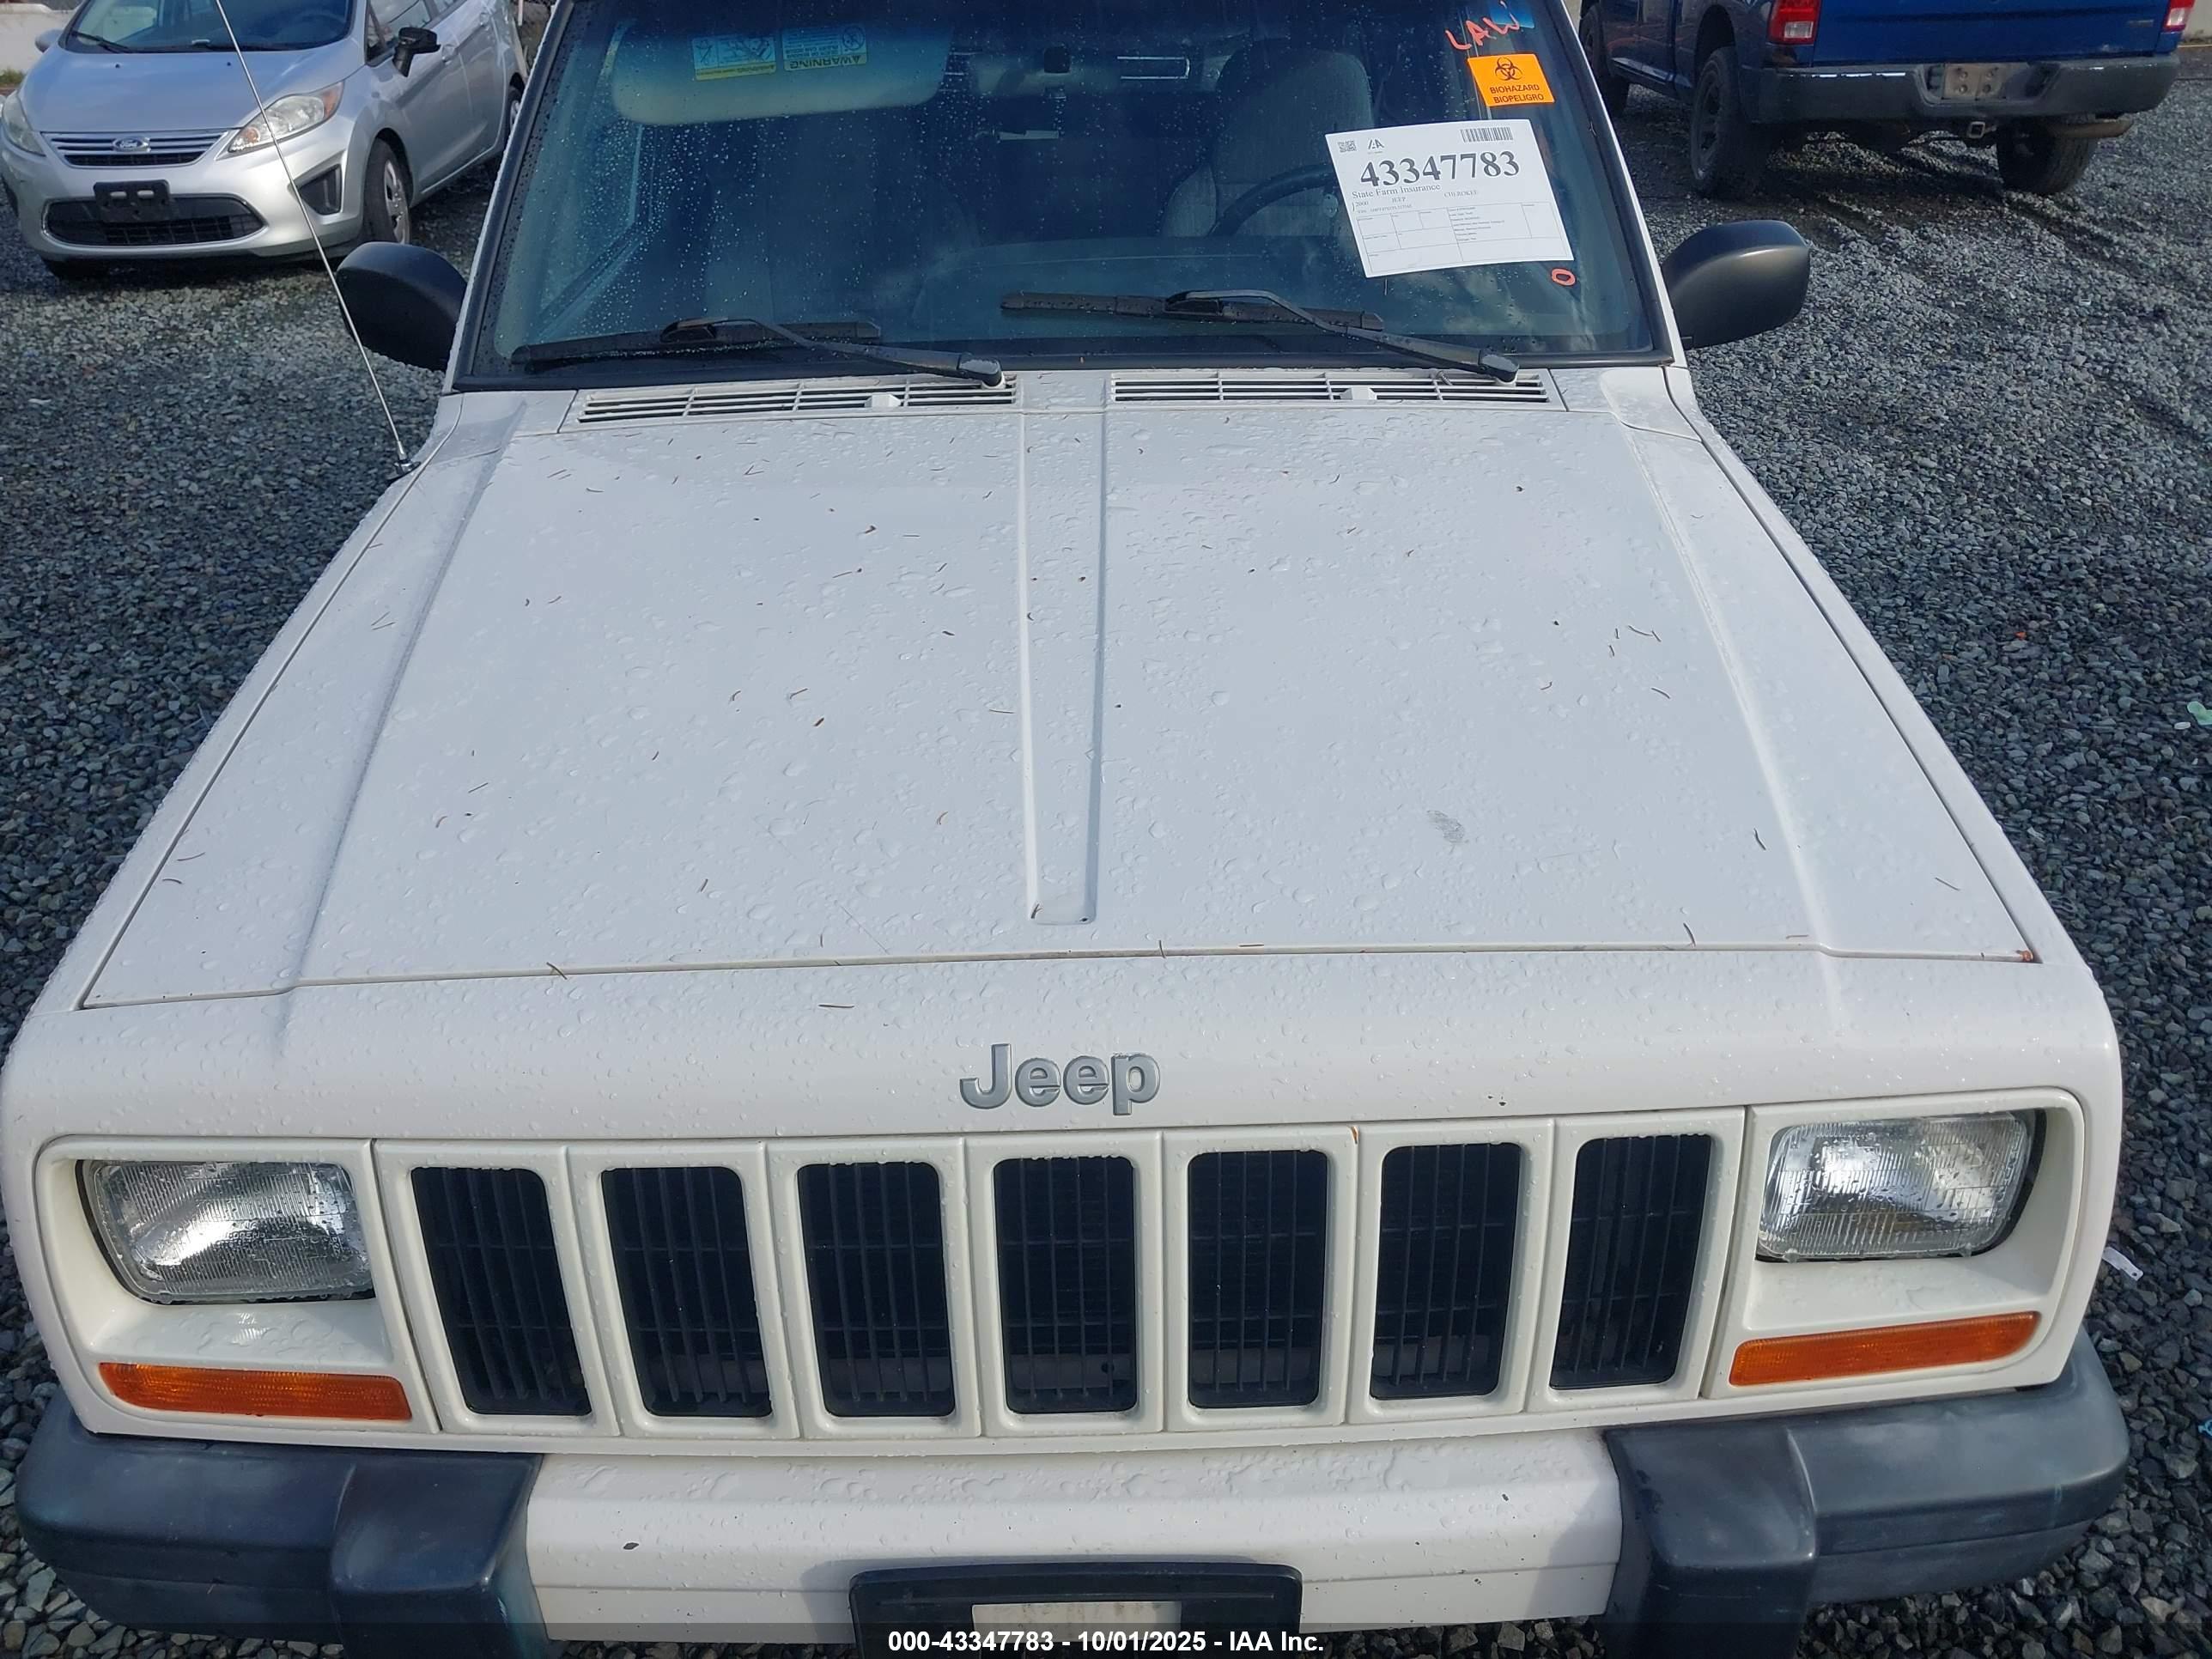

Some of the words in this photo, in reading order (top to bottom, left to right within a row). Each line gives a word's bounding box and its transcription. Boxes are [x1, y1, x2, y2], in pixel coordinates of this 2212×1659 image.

[790, 56, 852, 69] WARNING
[1490, 84, 1540, 94] BIOHAZARD
[1494, 94, 1544, 103] BIOPELIGRO
[1360, 150, 1520, 186] 43347783
[1352, 189, 1373, 199] State
[1376, 186, 1398, 196] Farm
[1400, 183, 1441, 194] Insurance
[1444, 190, 1478, 198] CHEROKEE
[960, 1043, 1160, 1115] Jeep
